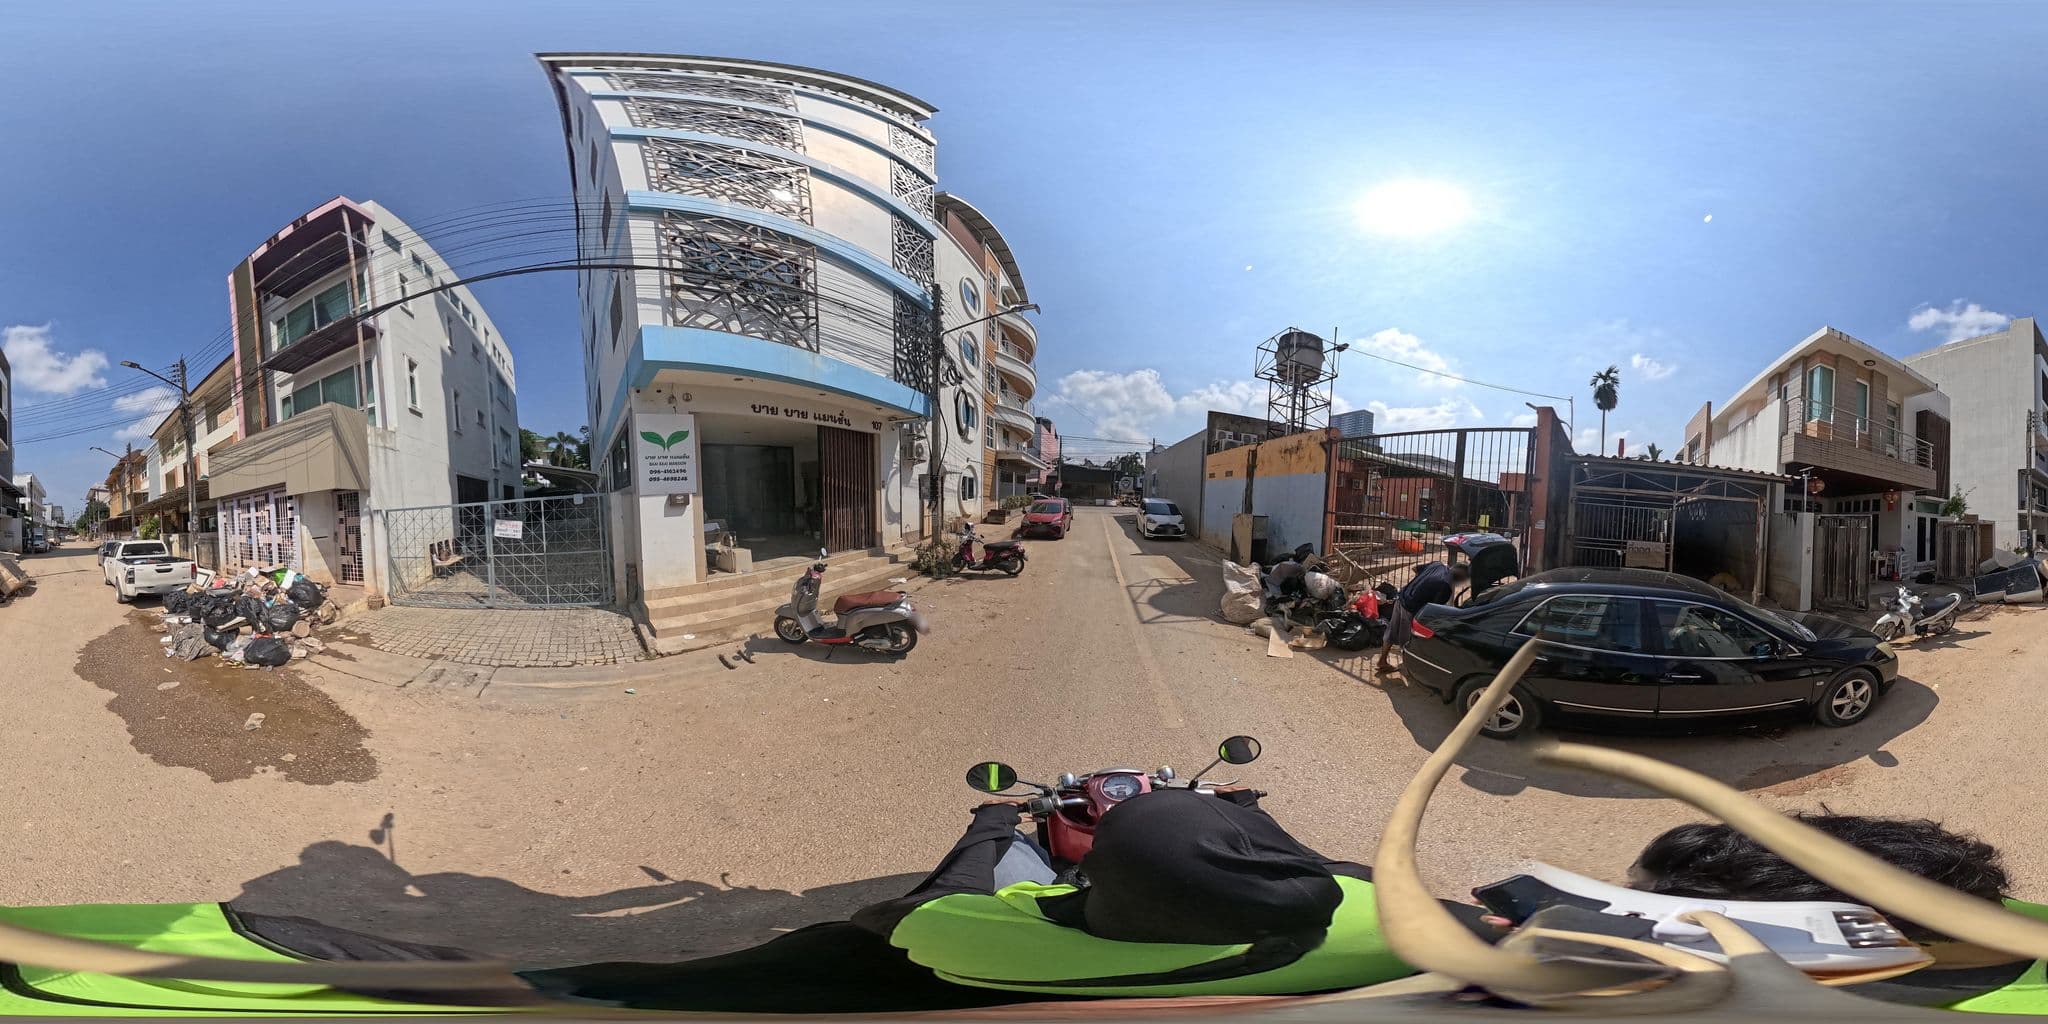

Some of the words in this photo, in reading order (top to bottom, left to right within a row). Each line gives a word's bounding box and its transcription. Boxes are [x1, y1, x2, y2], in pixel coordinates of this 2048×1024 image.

[751, 404, 778, 416] บาย
[783, 408, 808, 419] บาย
[813, 410, 851, 427] แมนชั่น
[871, 420, 883, 431] 107
